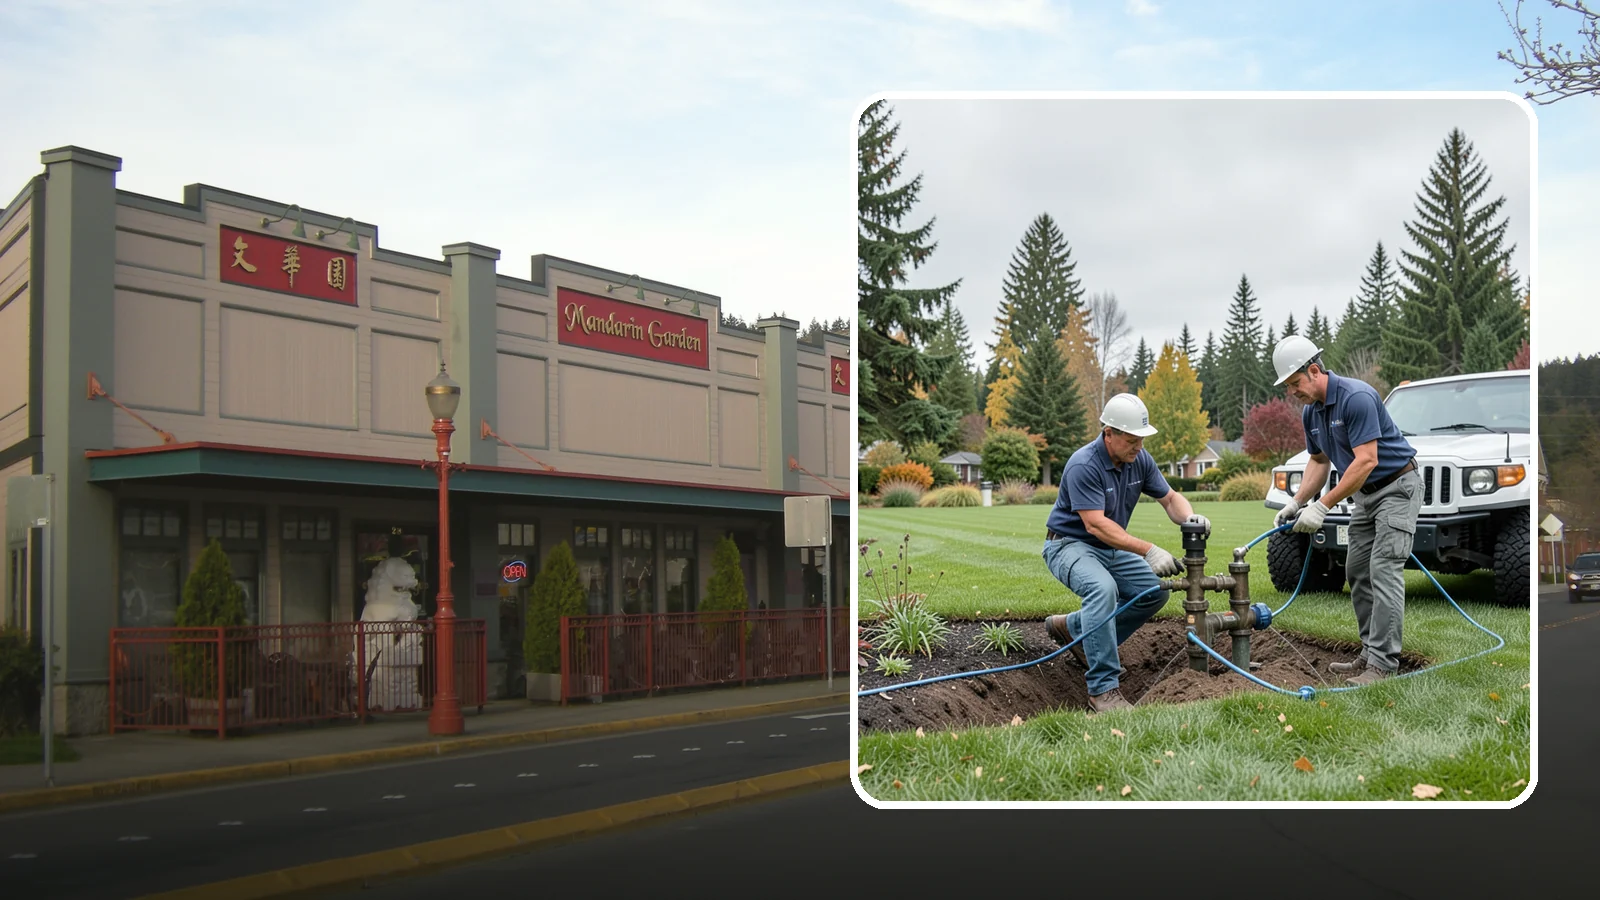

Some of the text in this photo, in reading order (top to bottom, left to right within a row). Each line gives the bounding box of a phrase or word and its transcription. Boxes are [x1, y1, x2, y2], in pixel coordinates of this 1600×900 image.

[564, 302, 701, 352] Mandarin Garden
[503, 565, 527, 578] OPEN
